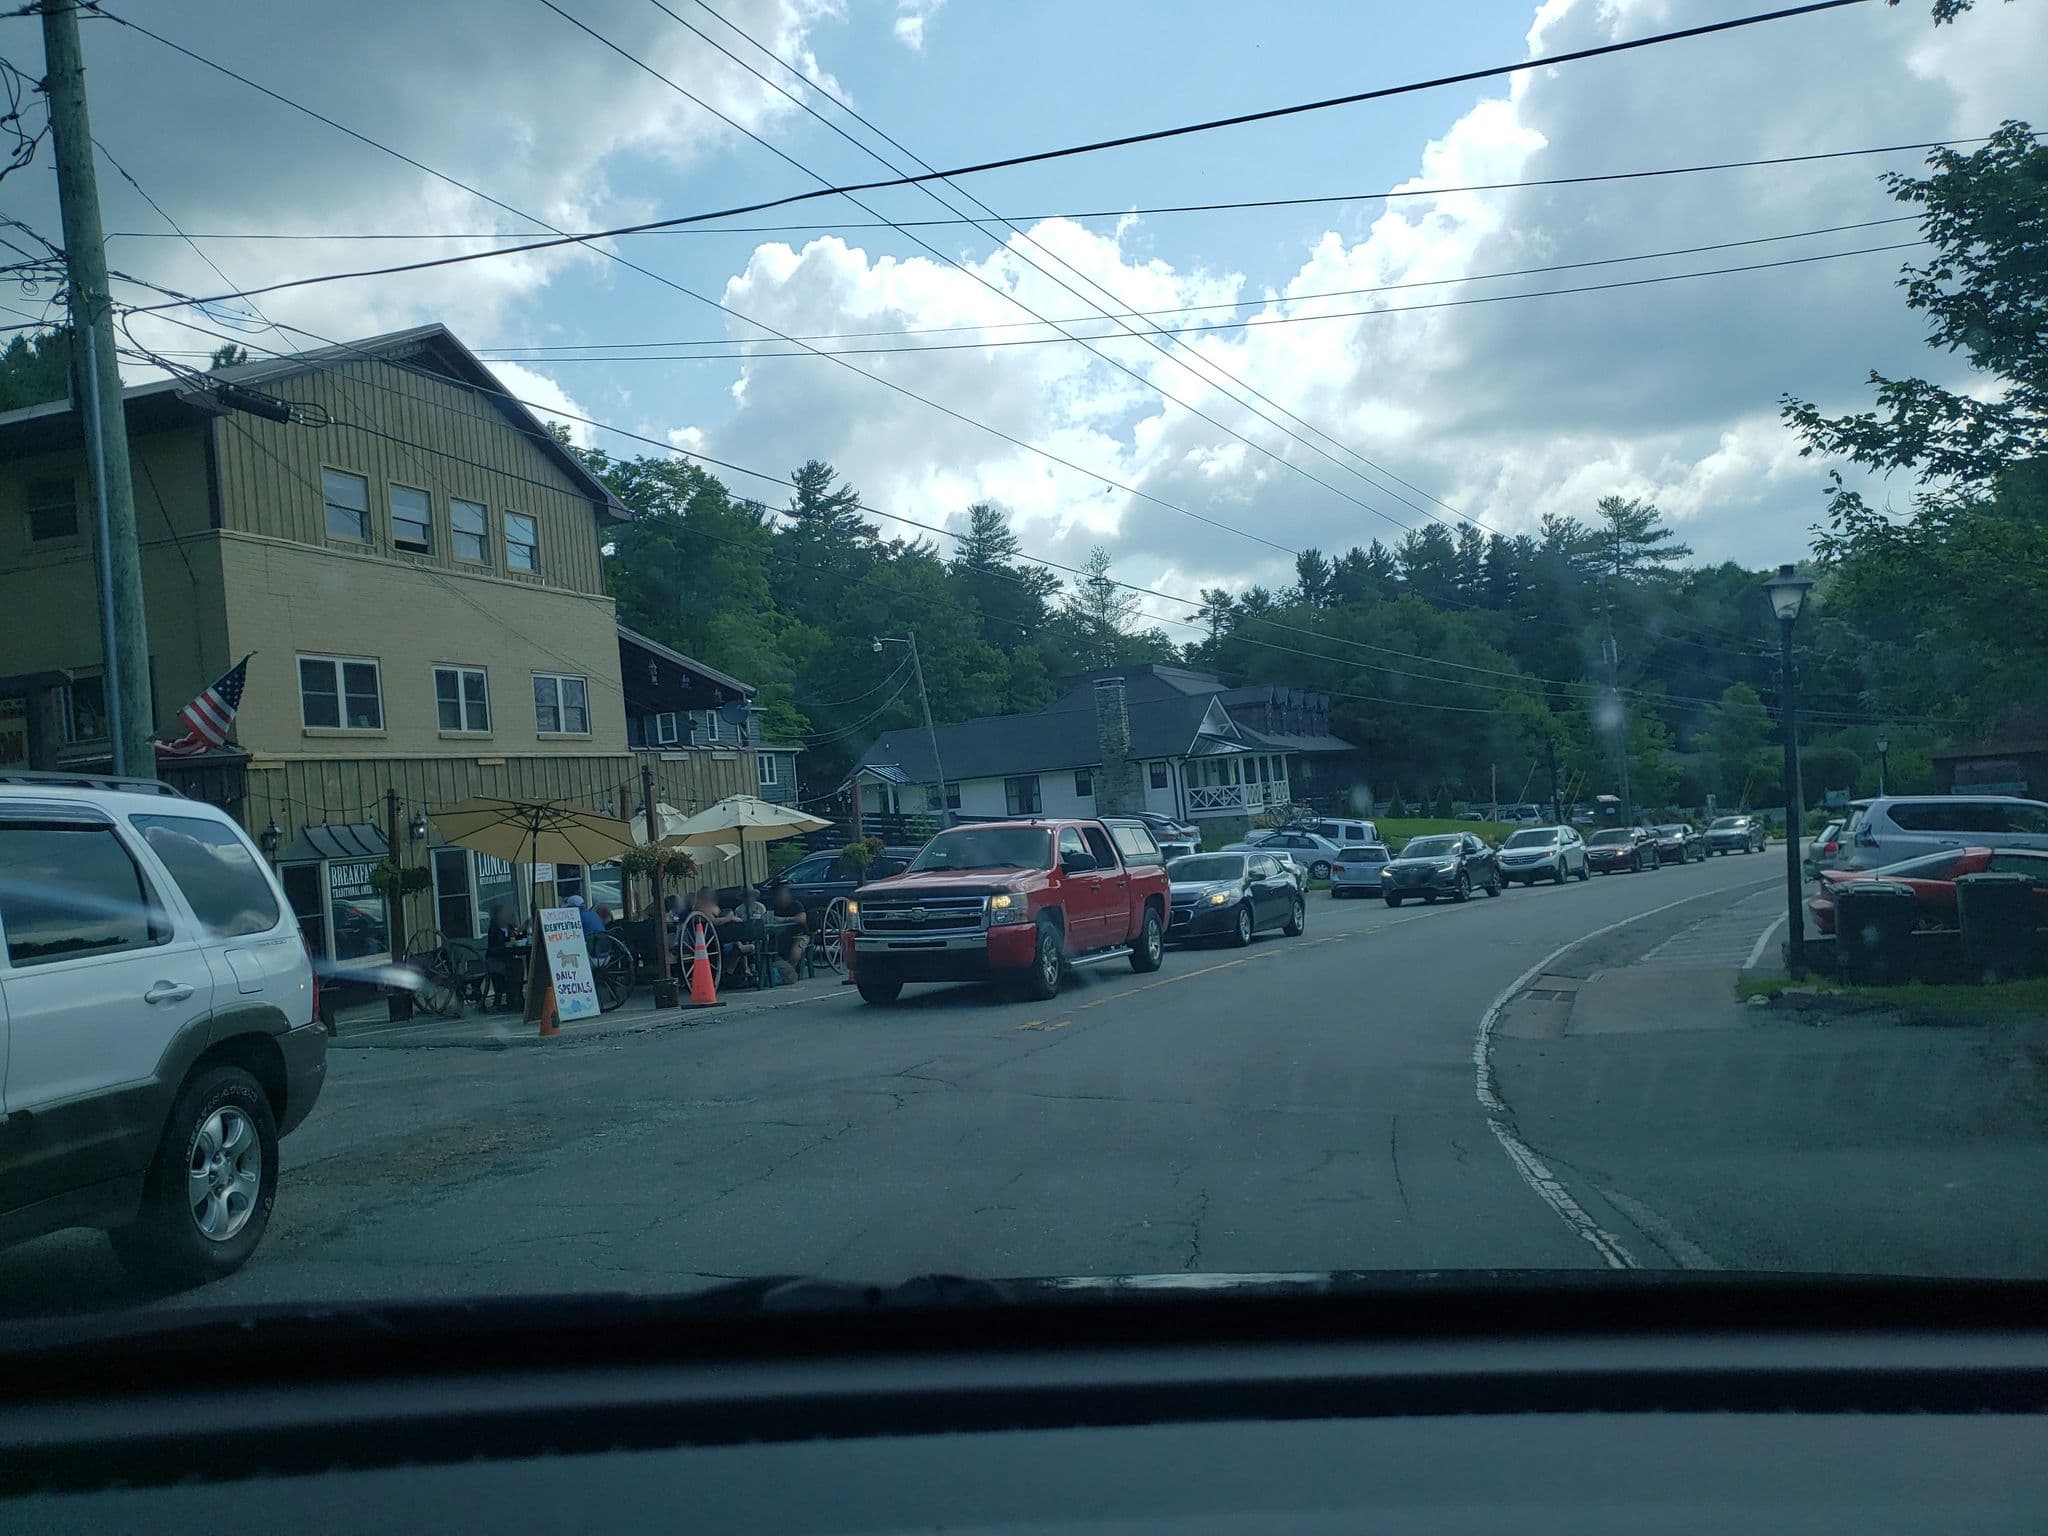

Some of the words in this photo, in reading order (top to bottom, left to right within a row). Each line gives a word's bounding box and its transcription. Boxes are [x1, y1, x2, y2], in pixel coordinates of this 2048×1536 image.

[478, 852, 510, 876] LUNCH
[556, 970, 576, 981] DAILY
[558, 981, 593, 995] SPECIALS
